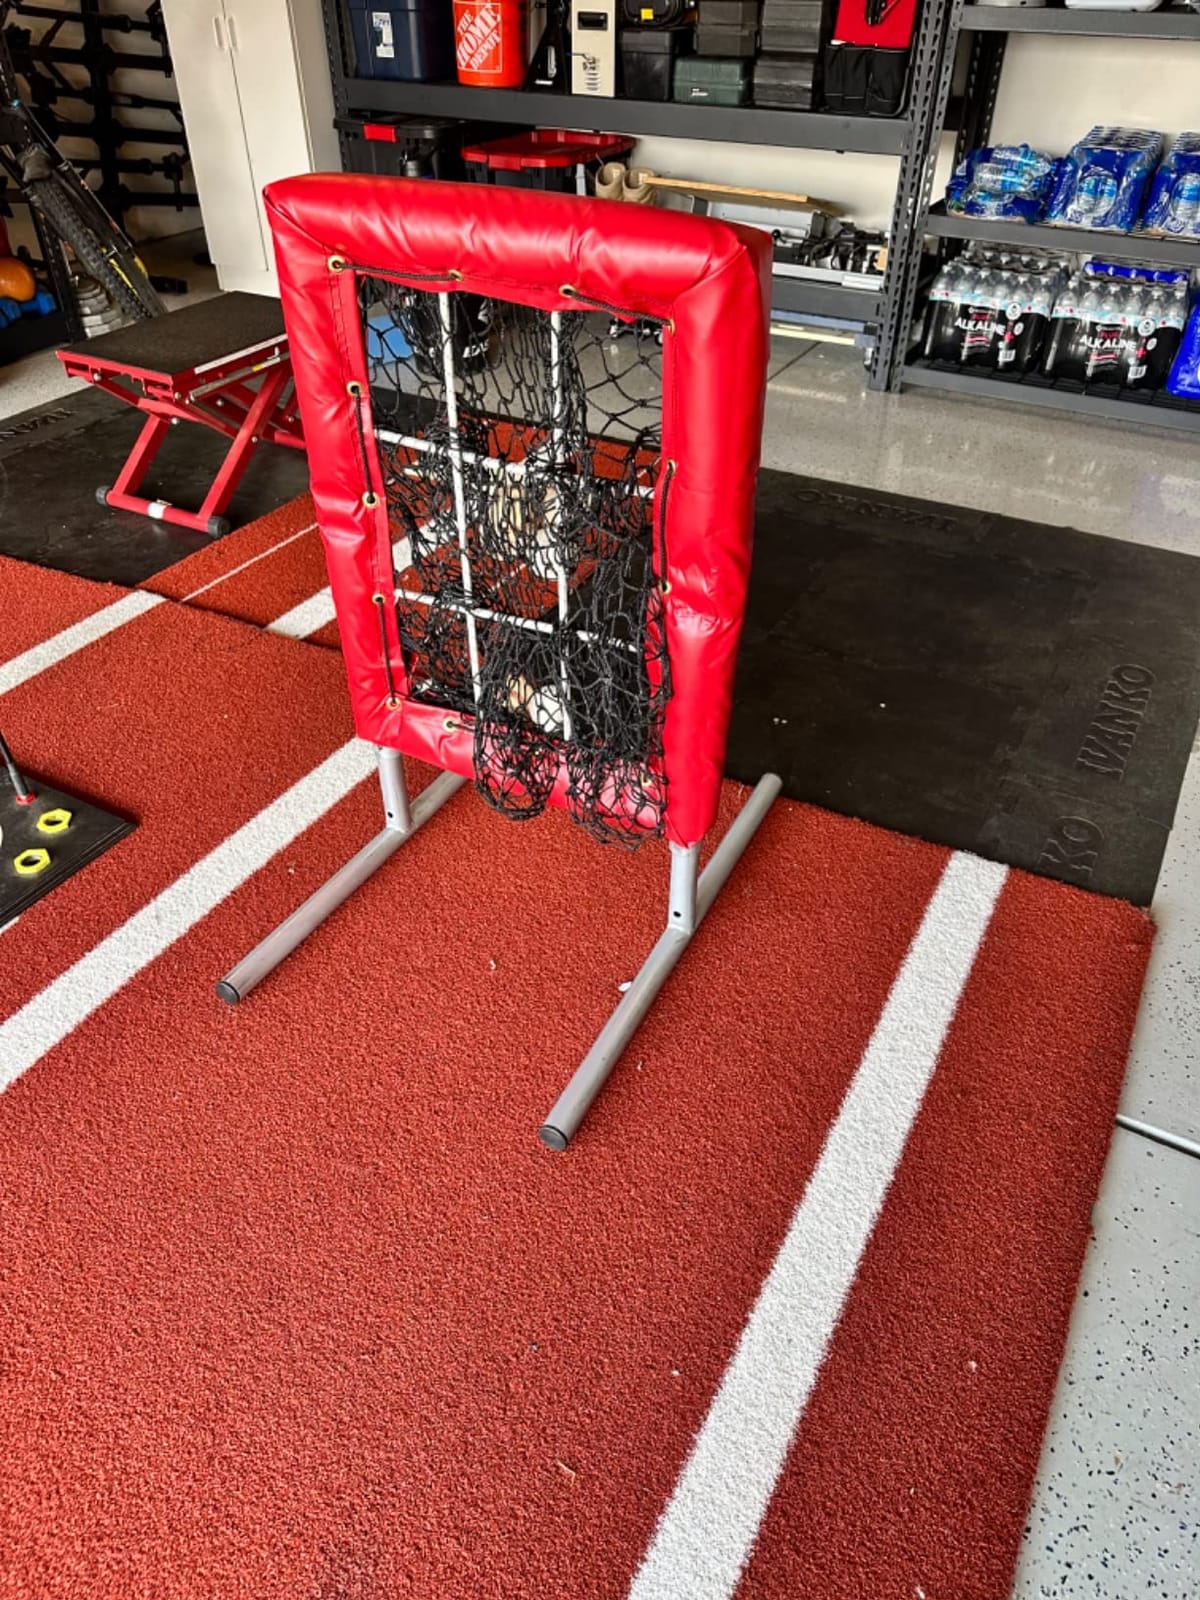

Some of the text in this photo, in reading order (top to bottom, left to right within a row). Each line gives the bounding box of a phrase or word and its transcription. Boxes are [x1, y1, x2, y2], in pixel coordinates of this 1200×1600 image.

[457, 9, 474, 36] THE
[457, 4, 500, 68] HOME
[470, 30, 501, 70] DEPOT
[954, 317, 1006, 336] ALKALINE
[1079, 334, 1138, 351] ALKALINE
[1075, 663, 1156, 782] IVANKO
